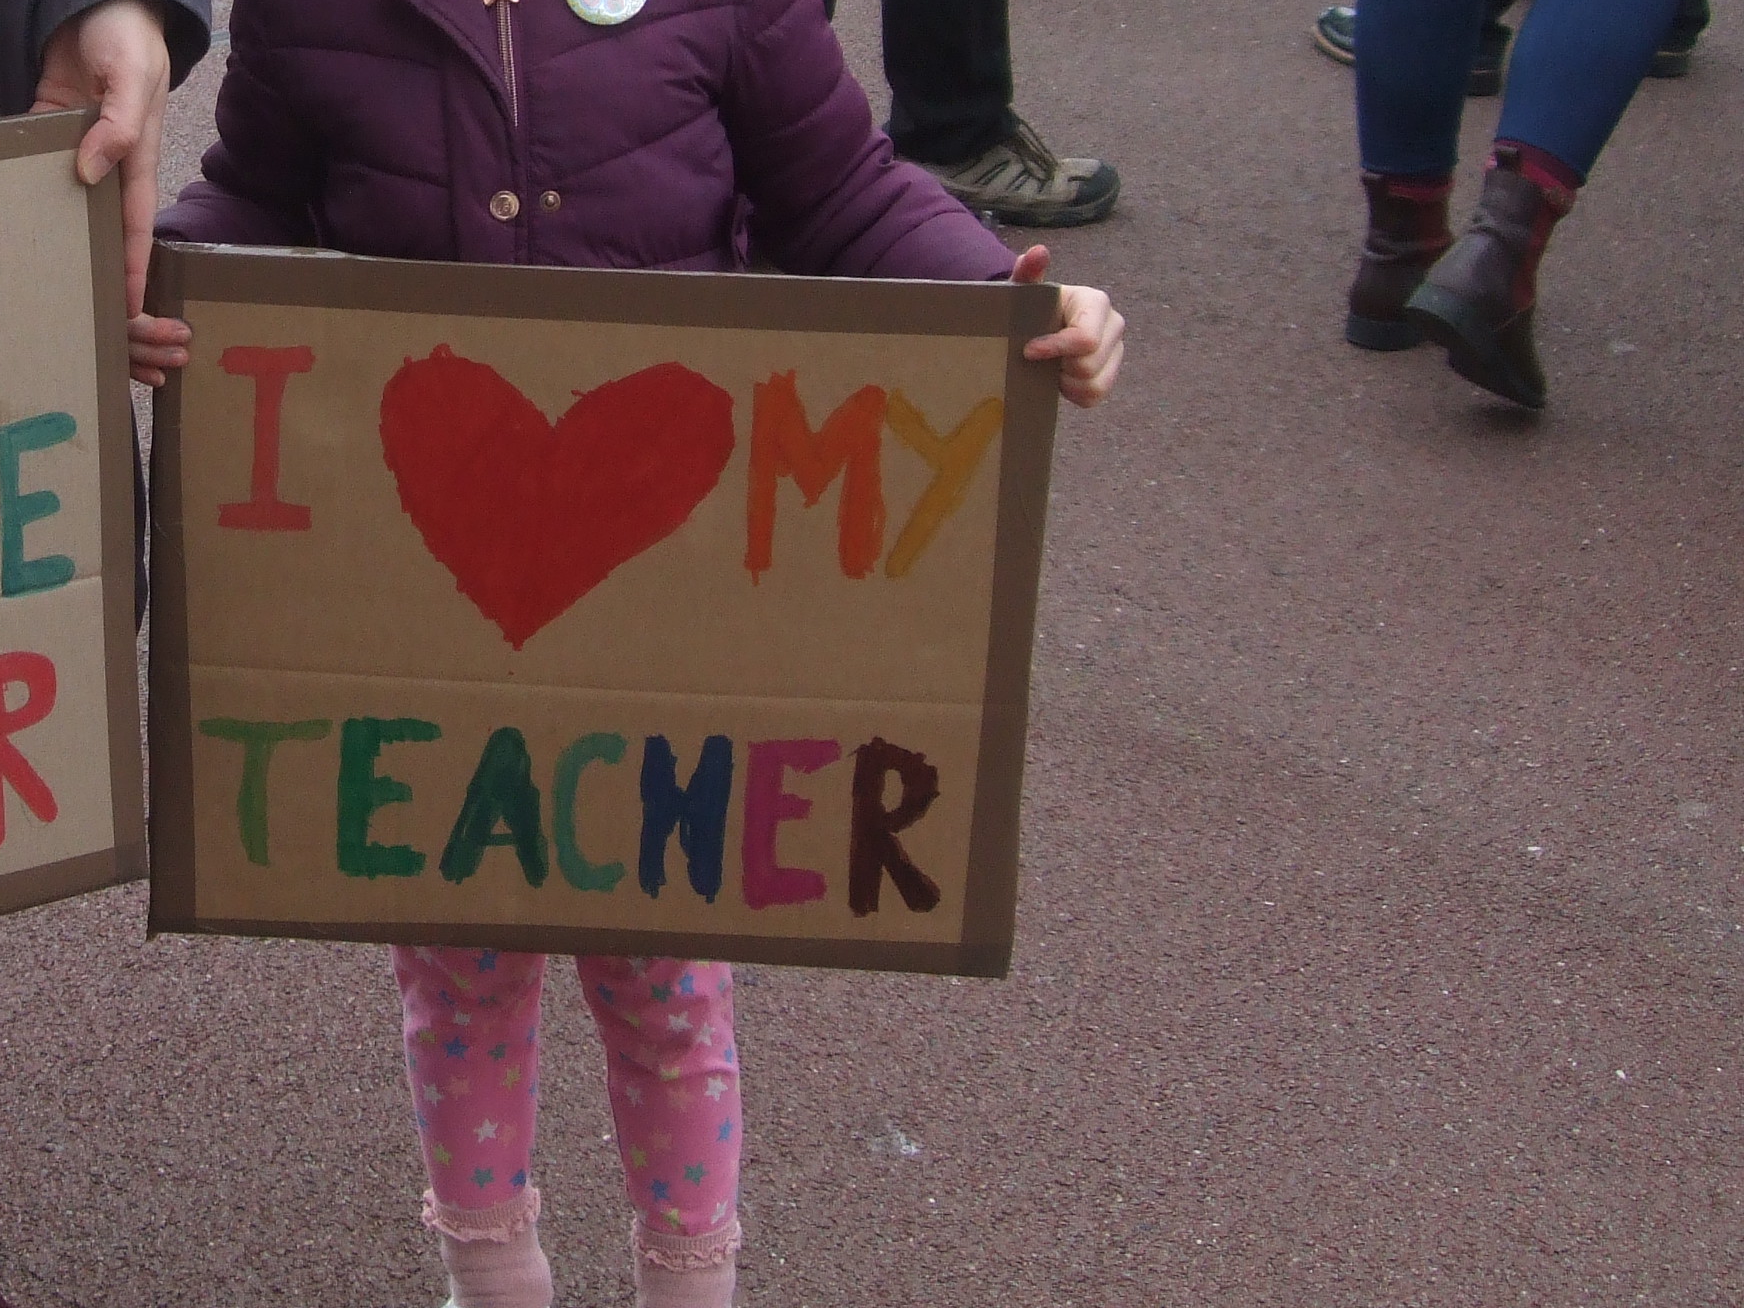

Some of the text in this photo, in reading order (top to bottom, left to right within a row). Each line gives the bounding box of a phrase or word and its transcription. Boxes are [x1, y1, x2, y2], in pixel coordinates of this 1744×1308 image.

[217, 345, 1004, 585] I MY
[198, 717, 942, 918] TEACHER
